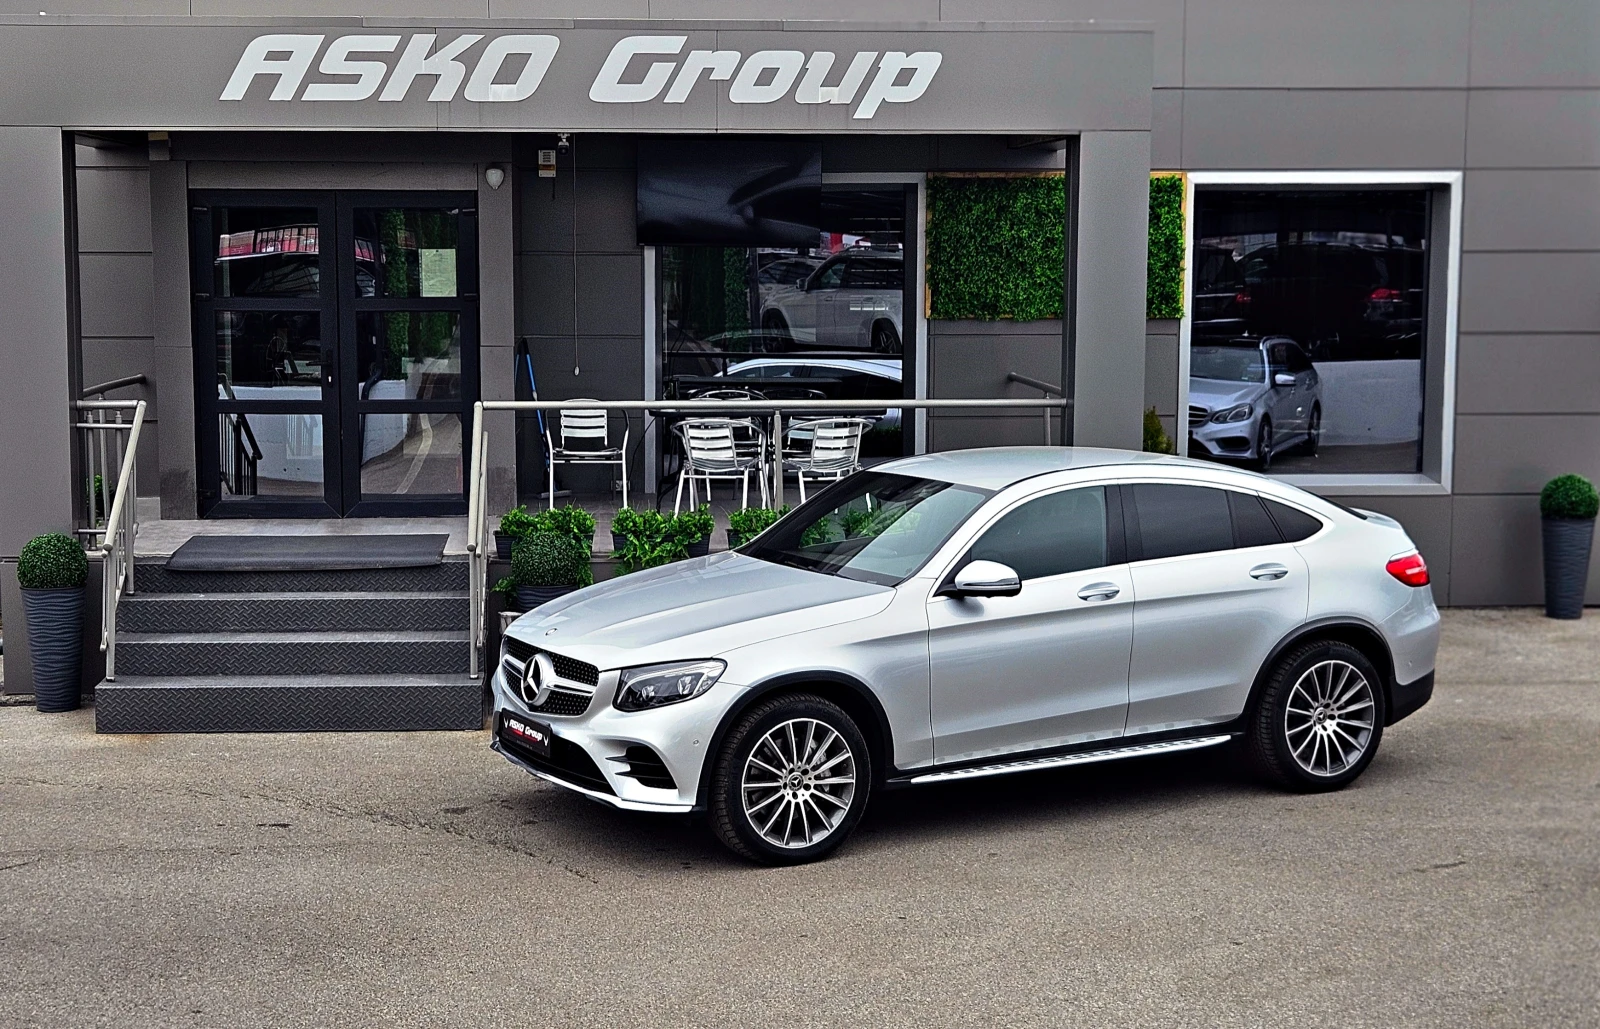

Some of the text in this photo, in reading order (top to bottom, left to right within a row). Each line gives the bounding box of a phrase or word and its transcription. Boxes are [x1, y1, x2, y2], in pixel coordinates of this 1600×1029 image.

[219, 34, 942, 119] ASKO Group
[509, 719, 543, 741] ASKO Group
